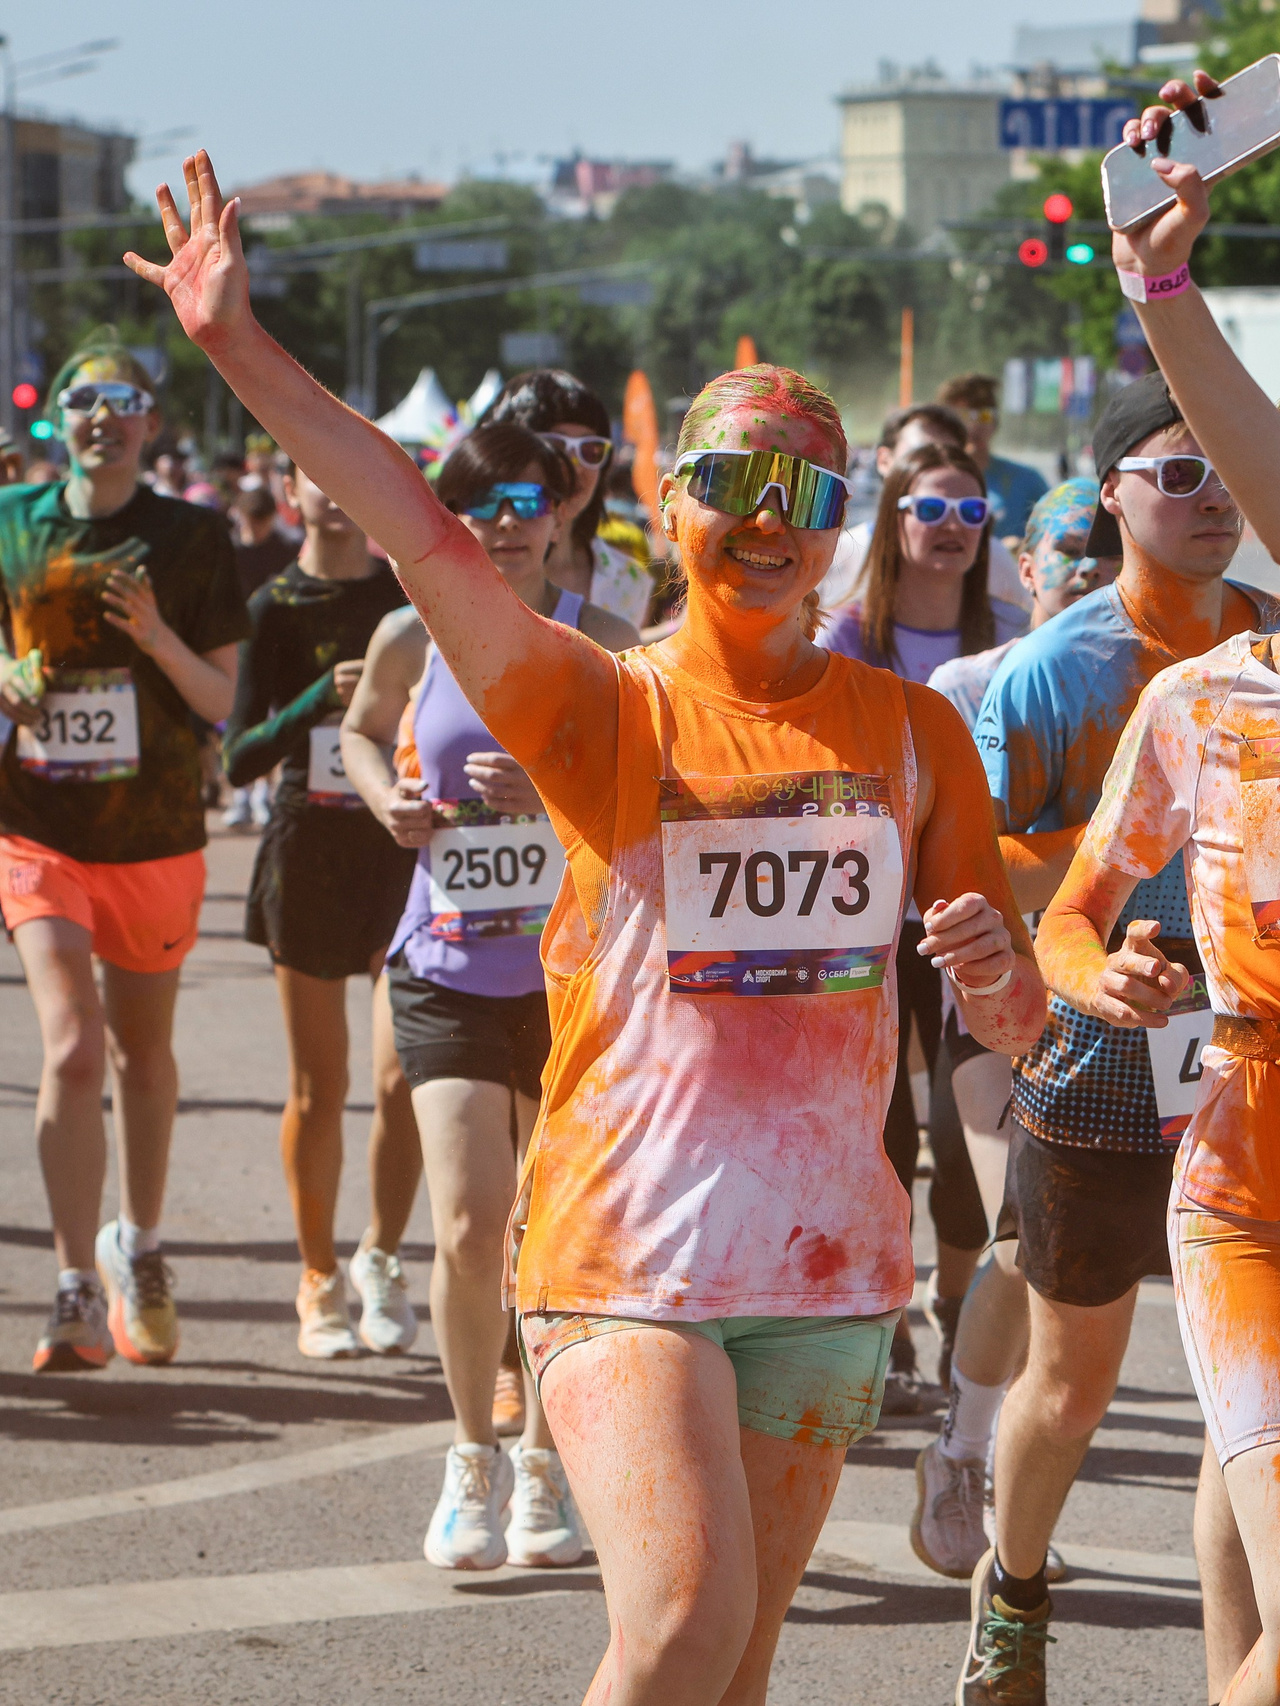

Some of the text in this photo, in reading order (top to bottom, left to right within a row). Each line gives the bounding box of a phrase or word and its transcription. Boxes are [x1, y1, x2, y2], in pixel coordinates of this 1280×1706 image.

[35, 708, 115, 744] 3132
[801, 801, 892, 818] 2026
[443, 843, 546, 890] 2509
[699, 849, 870, 918] 7073
[828, 970, 849, 978] СБЕР
